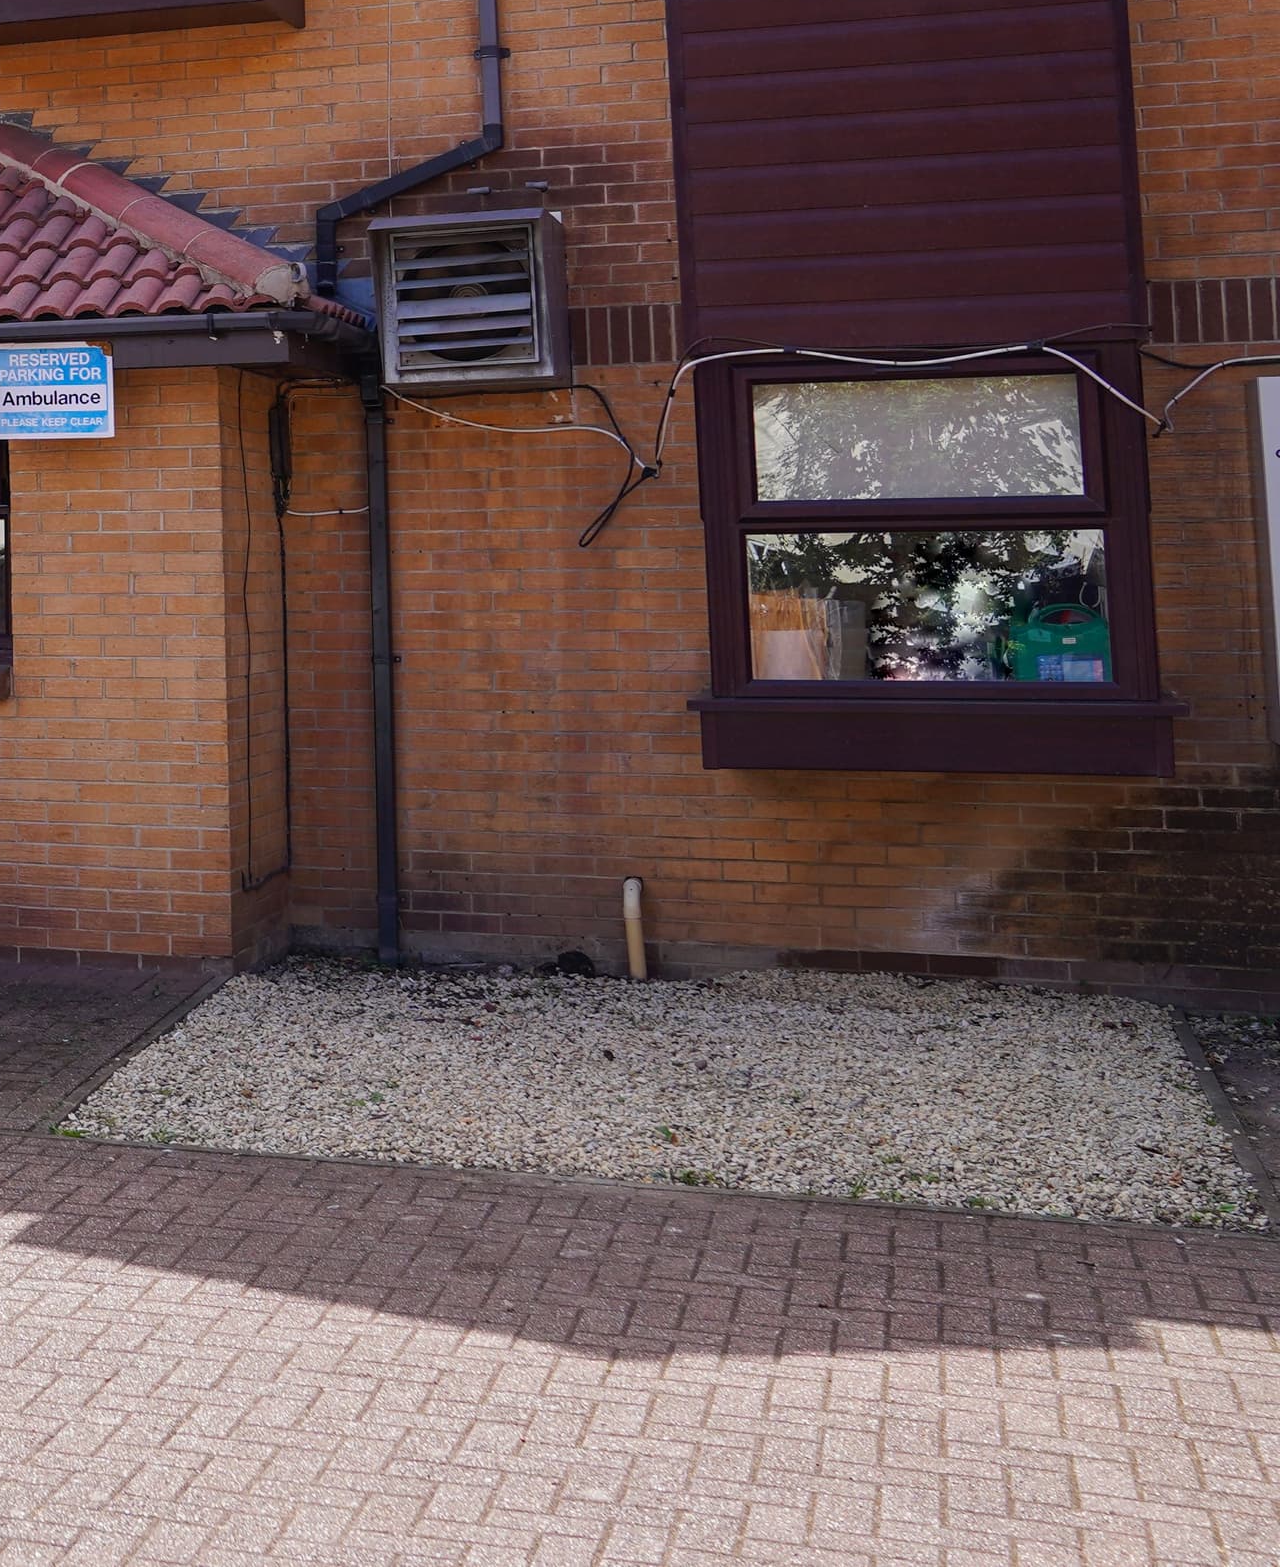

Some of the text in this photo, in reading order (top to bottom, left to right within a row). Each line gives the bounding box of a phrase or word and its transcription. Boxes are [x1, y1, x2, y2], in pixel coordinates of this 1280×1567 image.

[9, 352, 90, 367] RESERVED
[0, 367, 102, 382] PARKING FOR
[2, 390, 101, 406] Ambulance
[0, 416, 104, 427] PLEASE KEEP CLEAR
